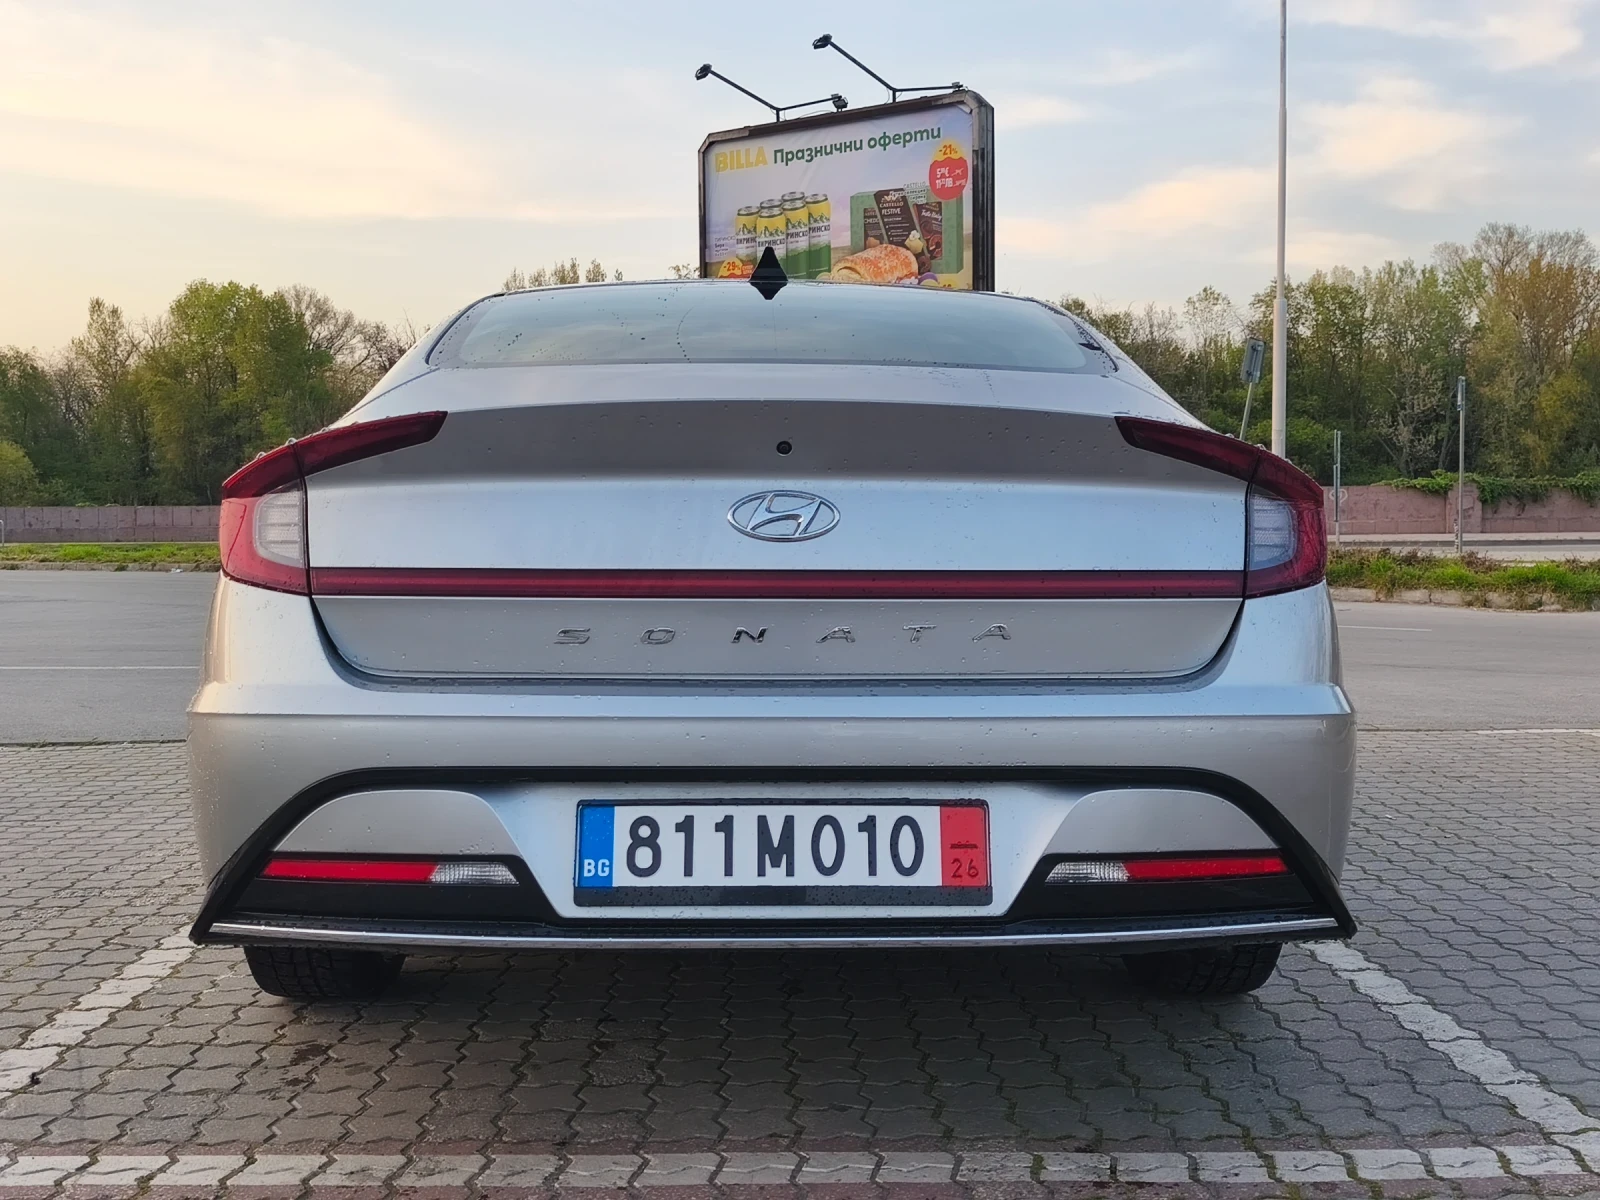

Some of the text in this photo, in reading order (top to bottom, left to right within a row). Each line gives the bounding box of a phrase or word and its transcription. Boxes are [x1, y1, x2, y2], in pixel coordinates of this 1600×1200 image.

[773, 127, 942, 167] Празнични оферти
[715, 146, 768, 173] BILLA
[881, 207, 902, 216] FESTIVE
[786, 230, 808, 240] РИНСКО
[809, 224, 831, 235] РИНСКО
[553, 623, 1012, 645] SONATA
[626, 814, 925, 878] 811M010
[583, 858, 610, 877] BG
[951, 858, 979, 878] 26
